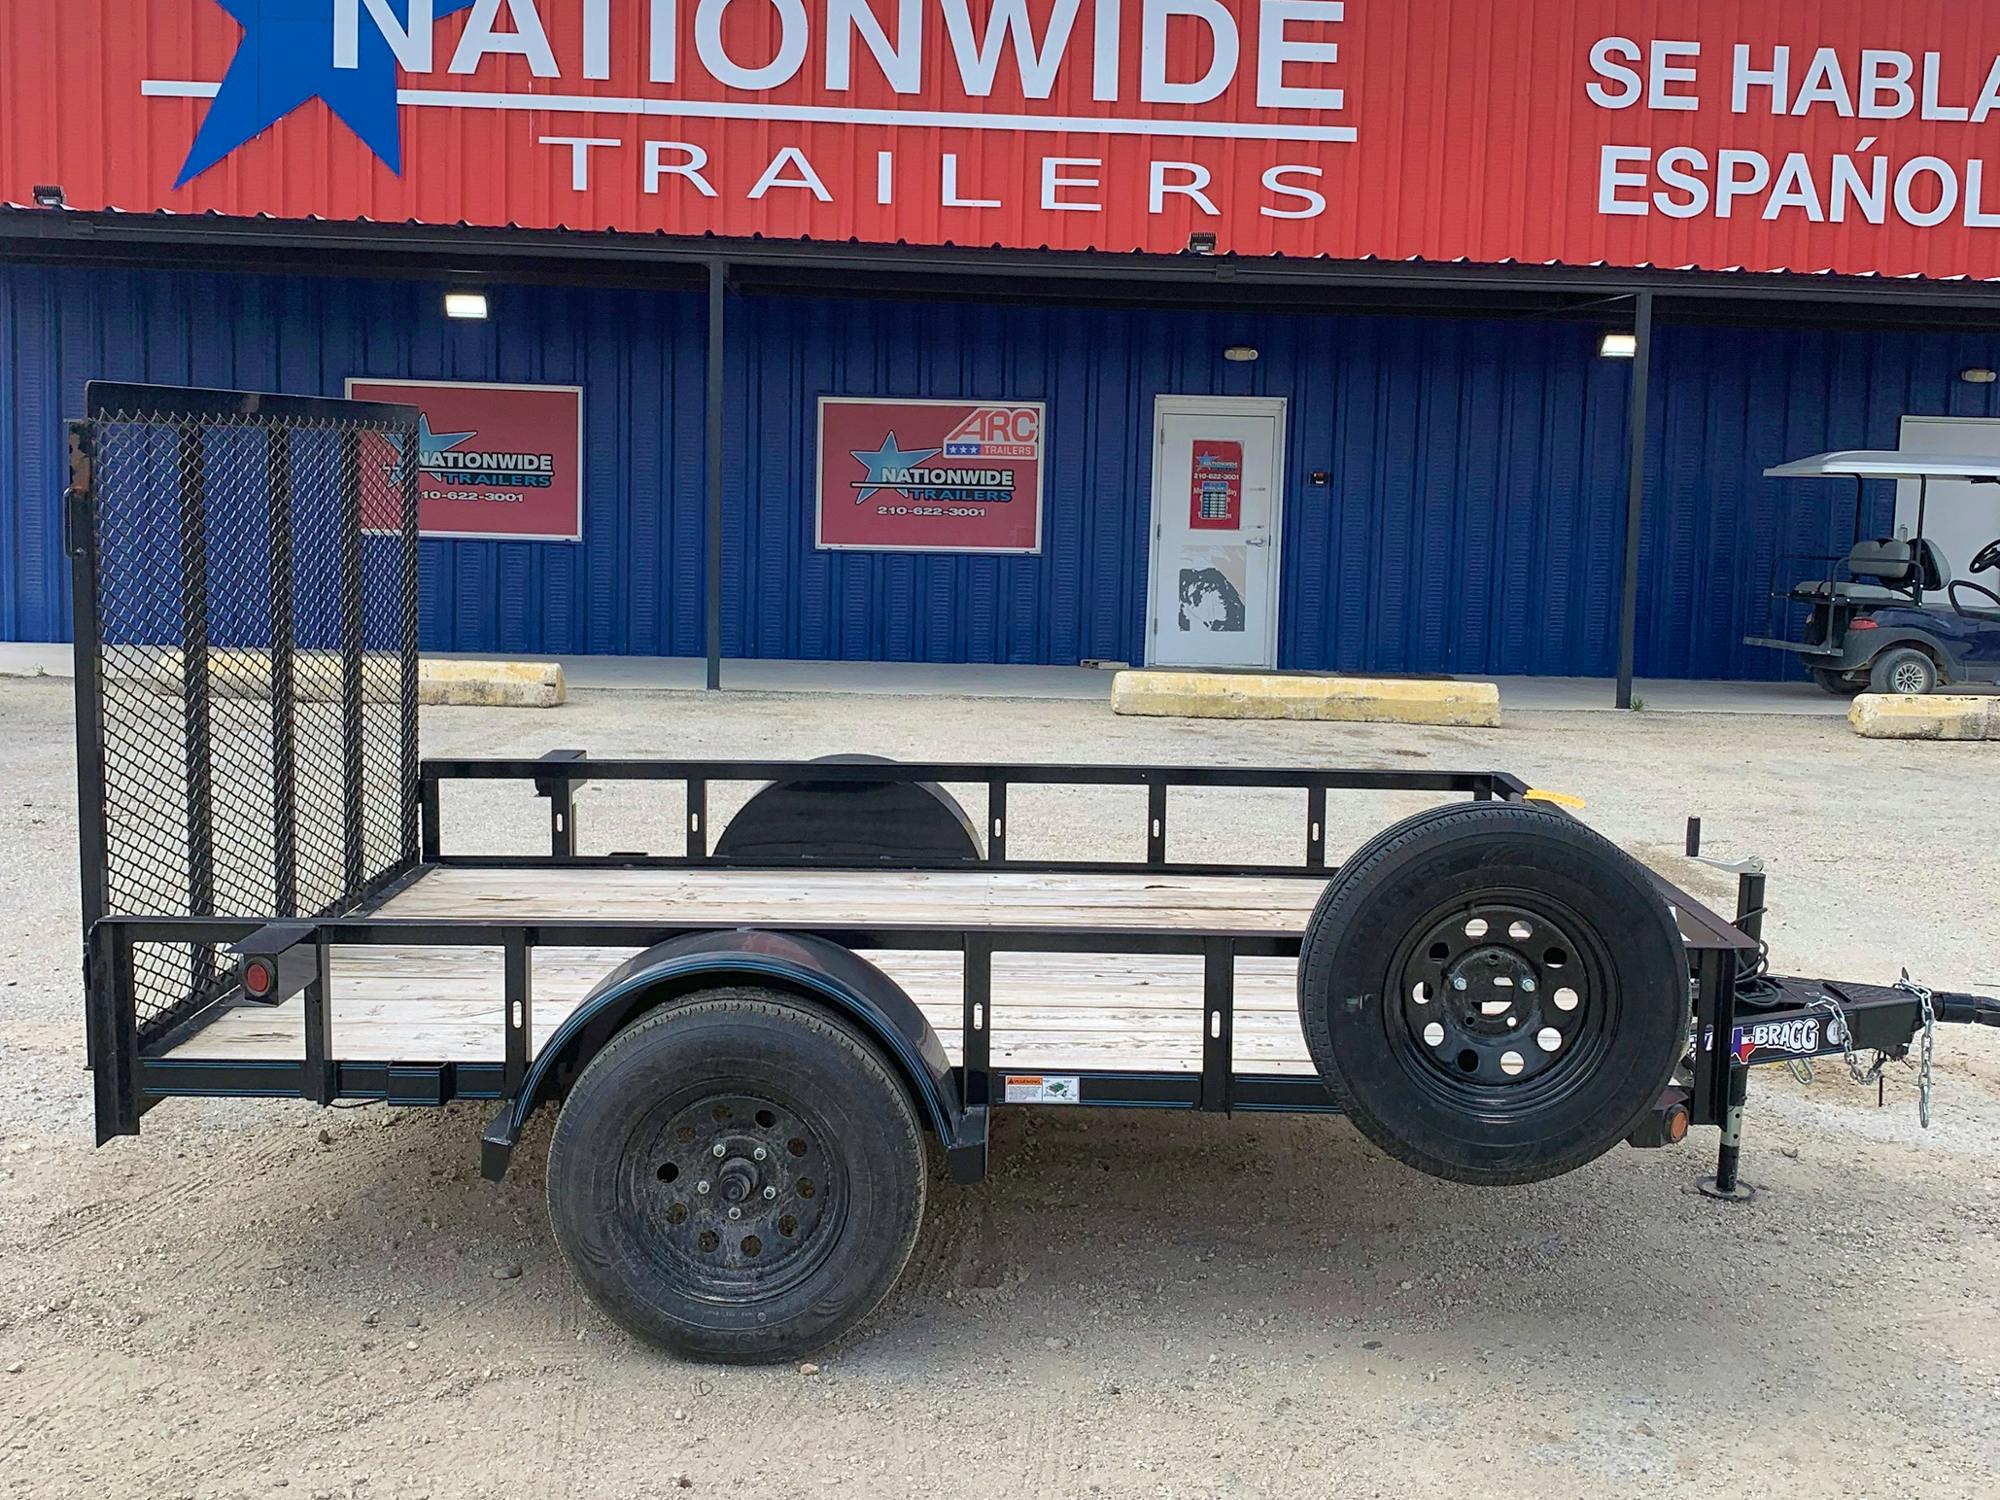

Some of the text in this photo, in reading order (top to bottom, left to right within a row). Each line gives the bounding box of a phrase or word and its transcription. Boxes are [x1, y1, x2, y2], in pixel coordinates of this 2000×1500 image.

[332, 0, 1345, 110] NATIONWIDE
[1585, 36, 1701, 111] SE
[538, 135, 1327, 219] TRAILERS
[950, 410, 1035, 442] ARC
[984, 445, 1032, 456] TRAILERS
[419, 452, 551, 469] NATIONWIDE
[444, 473, 550, 486] TRAILERS
[882, 469, 1013, 485] NATIONWIDE
[421, 490, 524, 502] 10-622-3001
[911, 489, 1012, 501] TRAILERS
[877, 506, 985, 516] 210-622-3001
[1755, 1020, 1817, 1051] BRAGG
